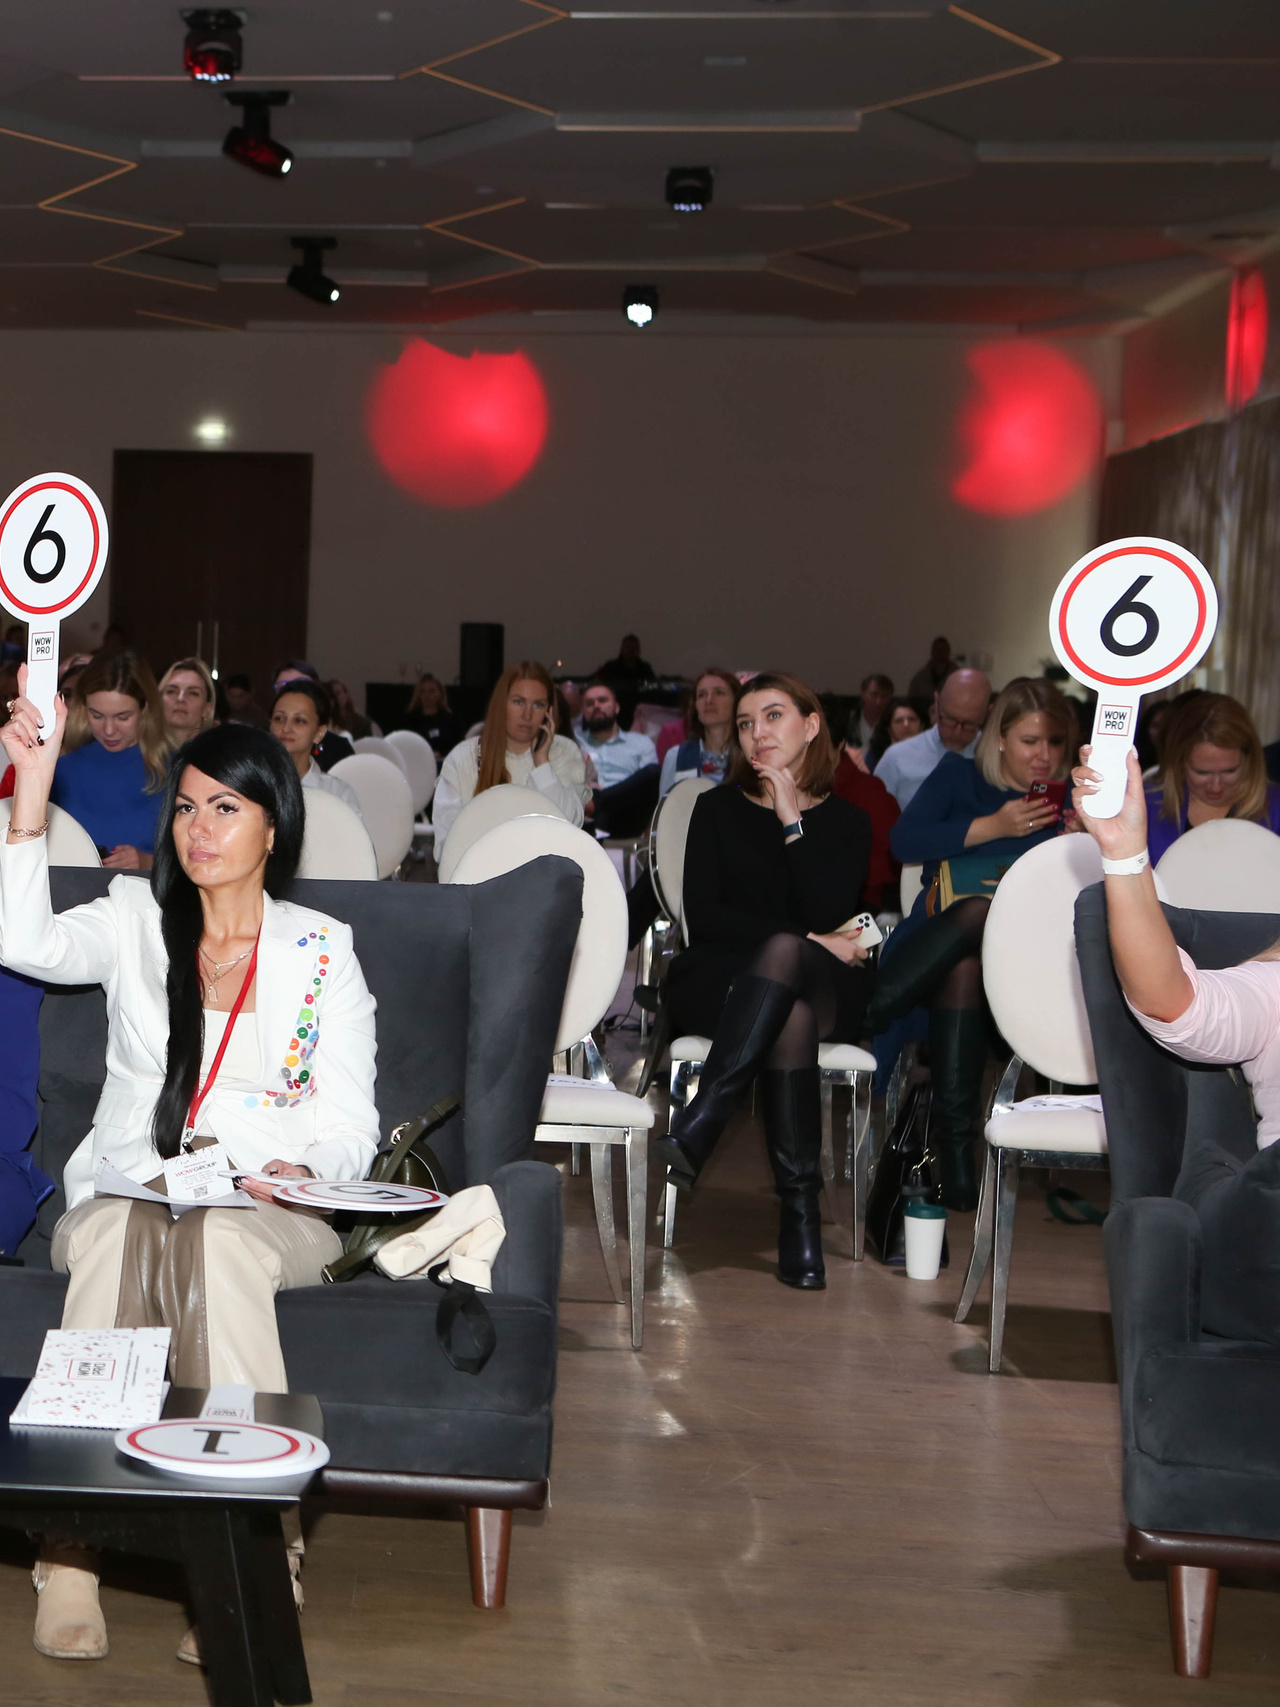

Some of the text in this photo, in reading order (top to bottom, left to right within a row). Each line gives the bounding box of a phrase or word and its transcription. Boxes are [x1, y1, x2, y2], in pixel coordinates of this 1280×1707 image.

[23, 504, 66, 584] 6
[1099, 575, 1160, 657] 6
[34, 636, 52, 646] WOW
[35, 646, 51, 655] PRO
[1104, 710, 1127, 720] WOW
[1104, 720, 1125, 730] PRO
[192, 1428, 241, 1455] 1
